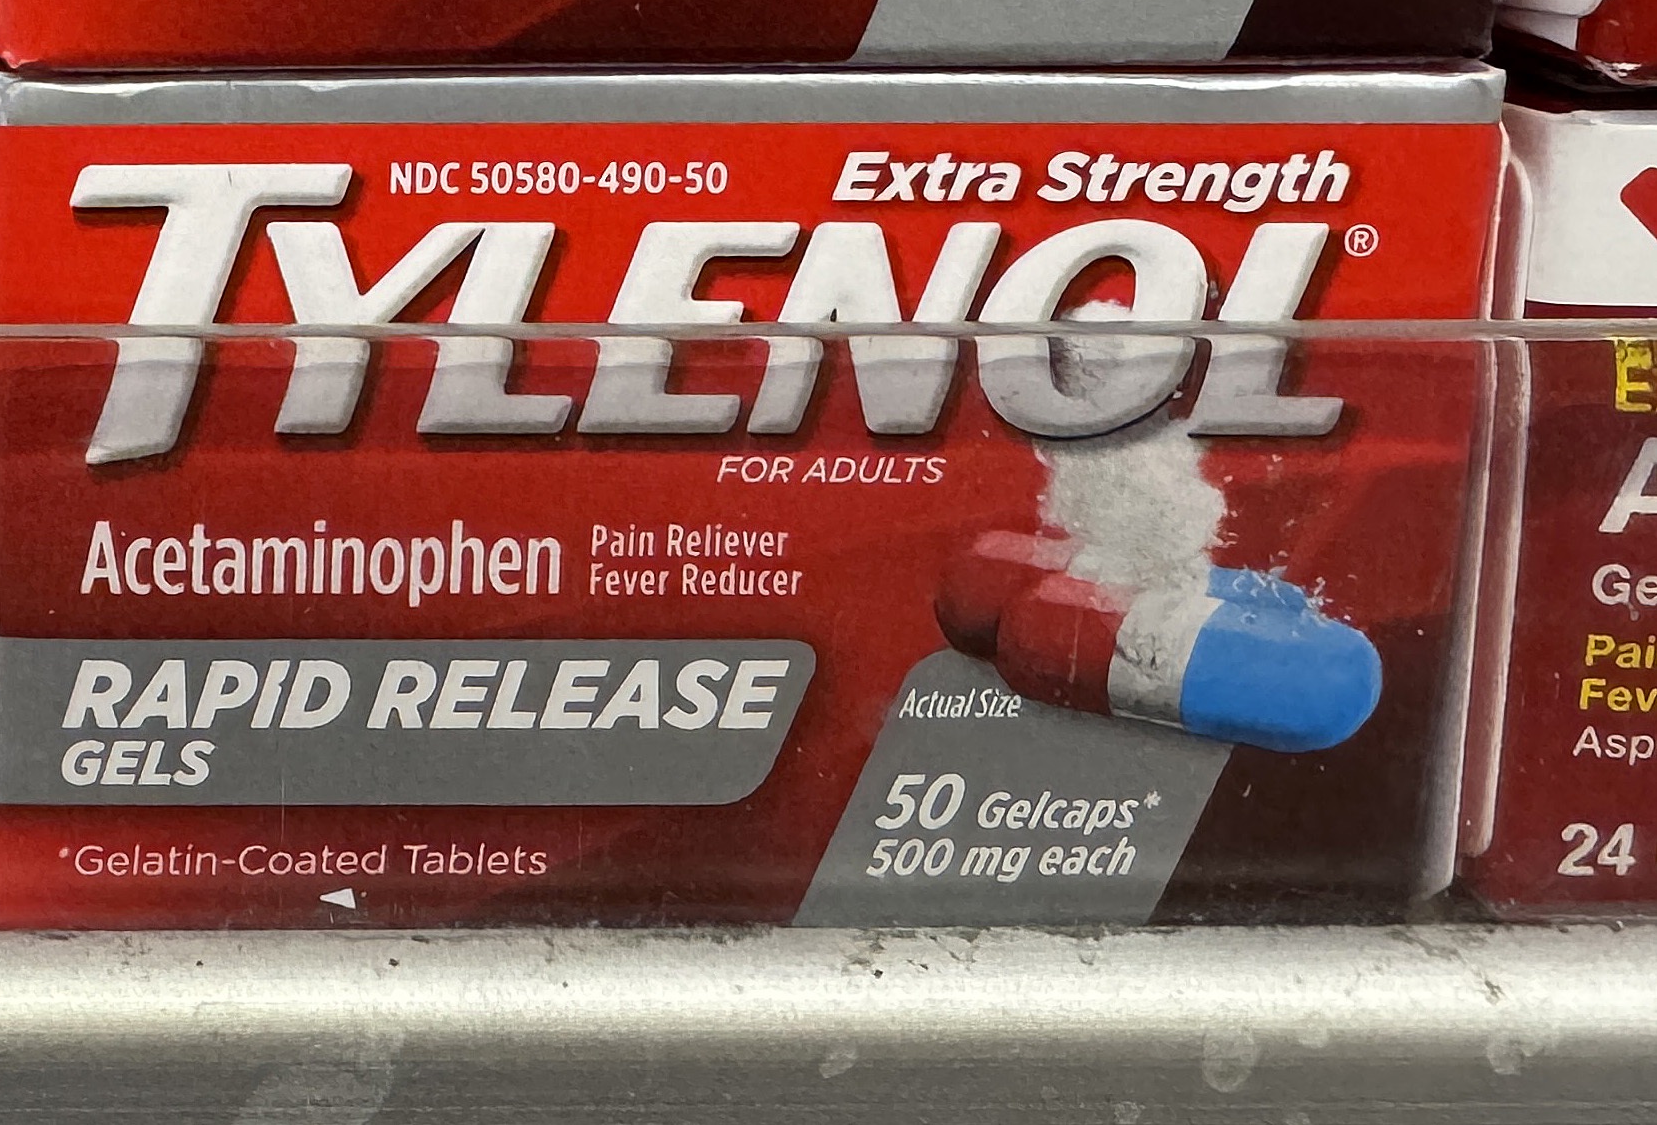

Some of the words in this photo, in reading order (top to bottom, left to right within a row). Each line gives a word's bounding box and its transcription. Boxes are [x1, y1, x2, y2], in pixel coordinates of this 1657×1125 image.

[390, 161, 459, 195] NDC
[469, 161, 728, 195] 50580-490-50
[832, 152, 1021, 203] Extra
[1038, 150, 1351, 212] Strength
[717, 455, 794, 484] FOR
[801, 455, 947, 484] ADULTS
[591, 524, 655, 558] Pain
[665, 523, 789, 557] Reliever
[80, 520, 561, 608] Acetaminophen
[589, 565, 668, 597] Fever
[681, 563, 803, 597] Reducer
[61, 659, 351, 730] RAPID
[367, 658, 790, 730] RELEASE
[899, 688, 975, 721] Actual
[978, 687, 1023, 720] Size
[60, 740, 216, 787] GELS
[1572, 725, 1655, 766] Asp
[874, 773, 966, 831] 50
[403, 843, 549, 877] Tablets
[866, 837, 954, 878] 500
[959, 842, 1032, 884] mg
[1037, 836, 1137, 877] each
[1556, 822, 1636, 876] 24
